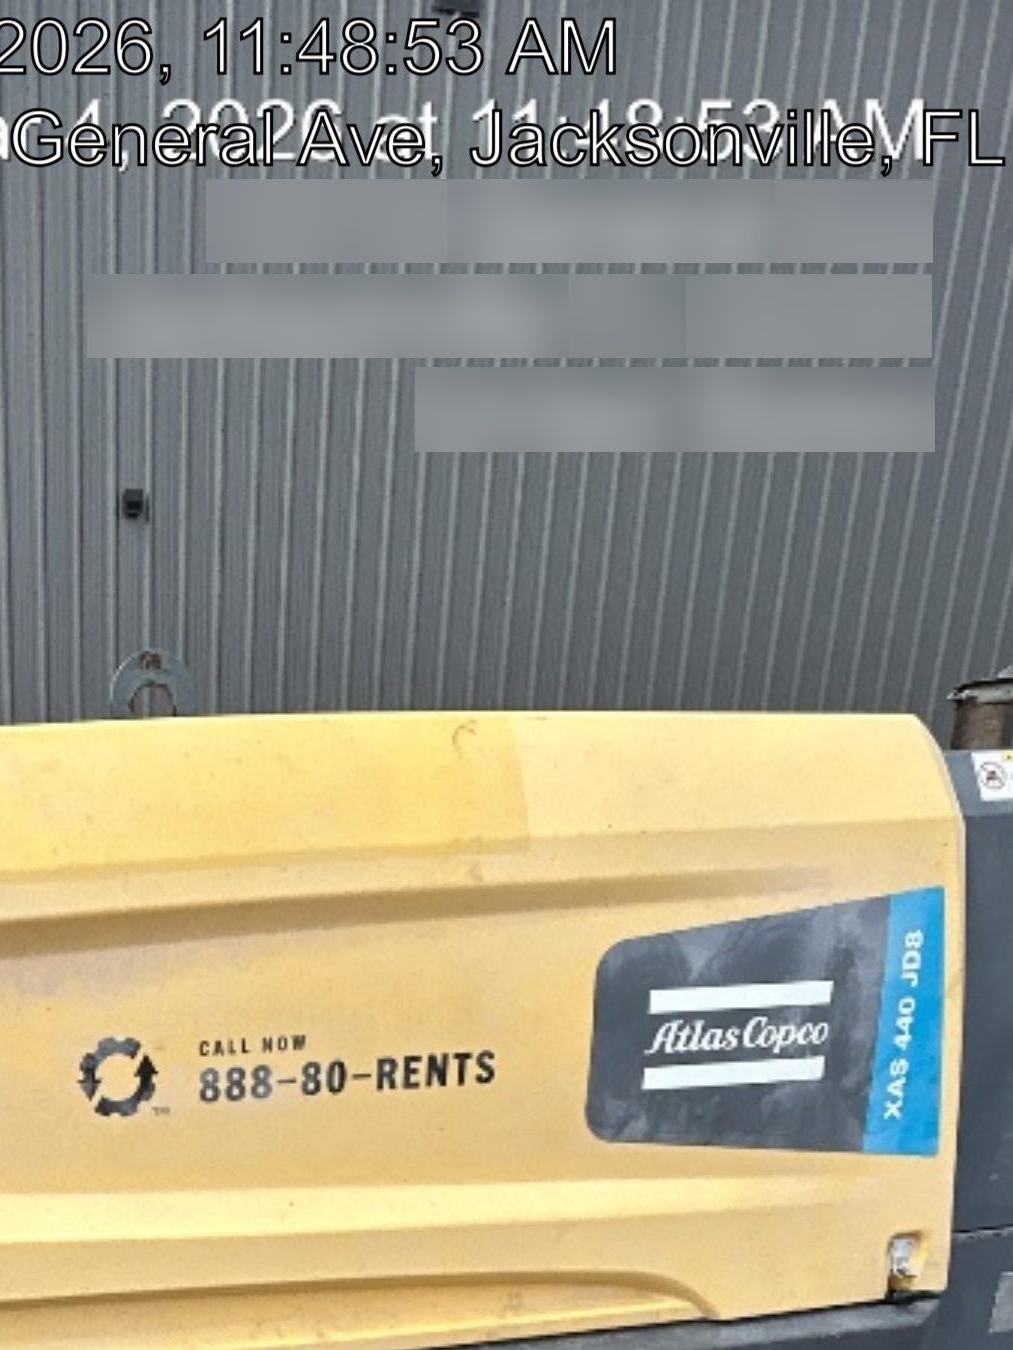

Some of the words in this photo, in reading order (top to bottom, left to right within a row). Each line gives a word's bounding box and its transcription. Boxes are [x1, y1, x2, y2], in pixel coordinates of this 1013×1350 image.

[901, 929, 925, 988] JD8
[199, 1038, 250, 1057] CALL
[262, 1034, 306, 1053] NOW
[644, 1019, 740, 1056] Atlas
[742, 1016, 830, 1054] Copco
[893, 996, 916, 1051] 440
[199, 1050, 496, 1103] 888-80-RENTS
[884, 1058, 910, 1120] XAS
